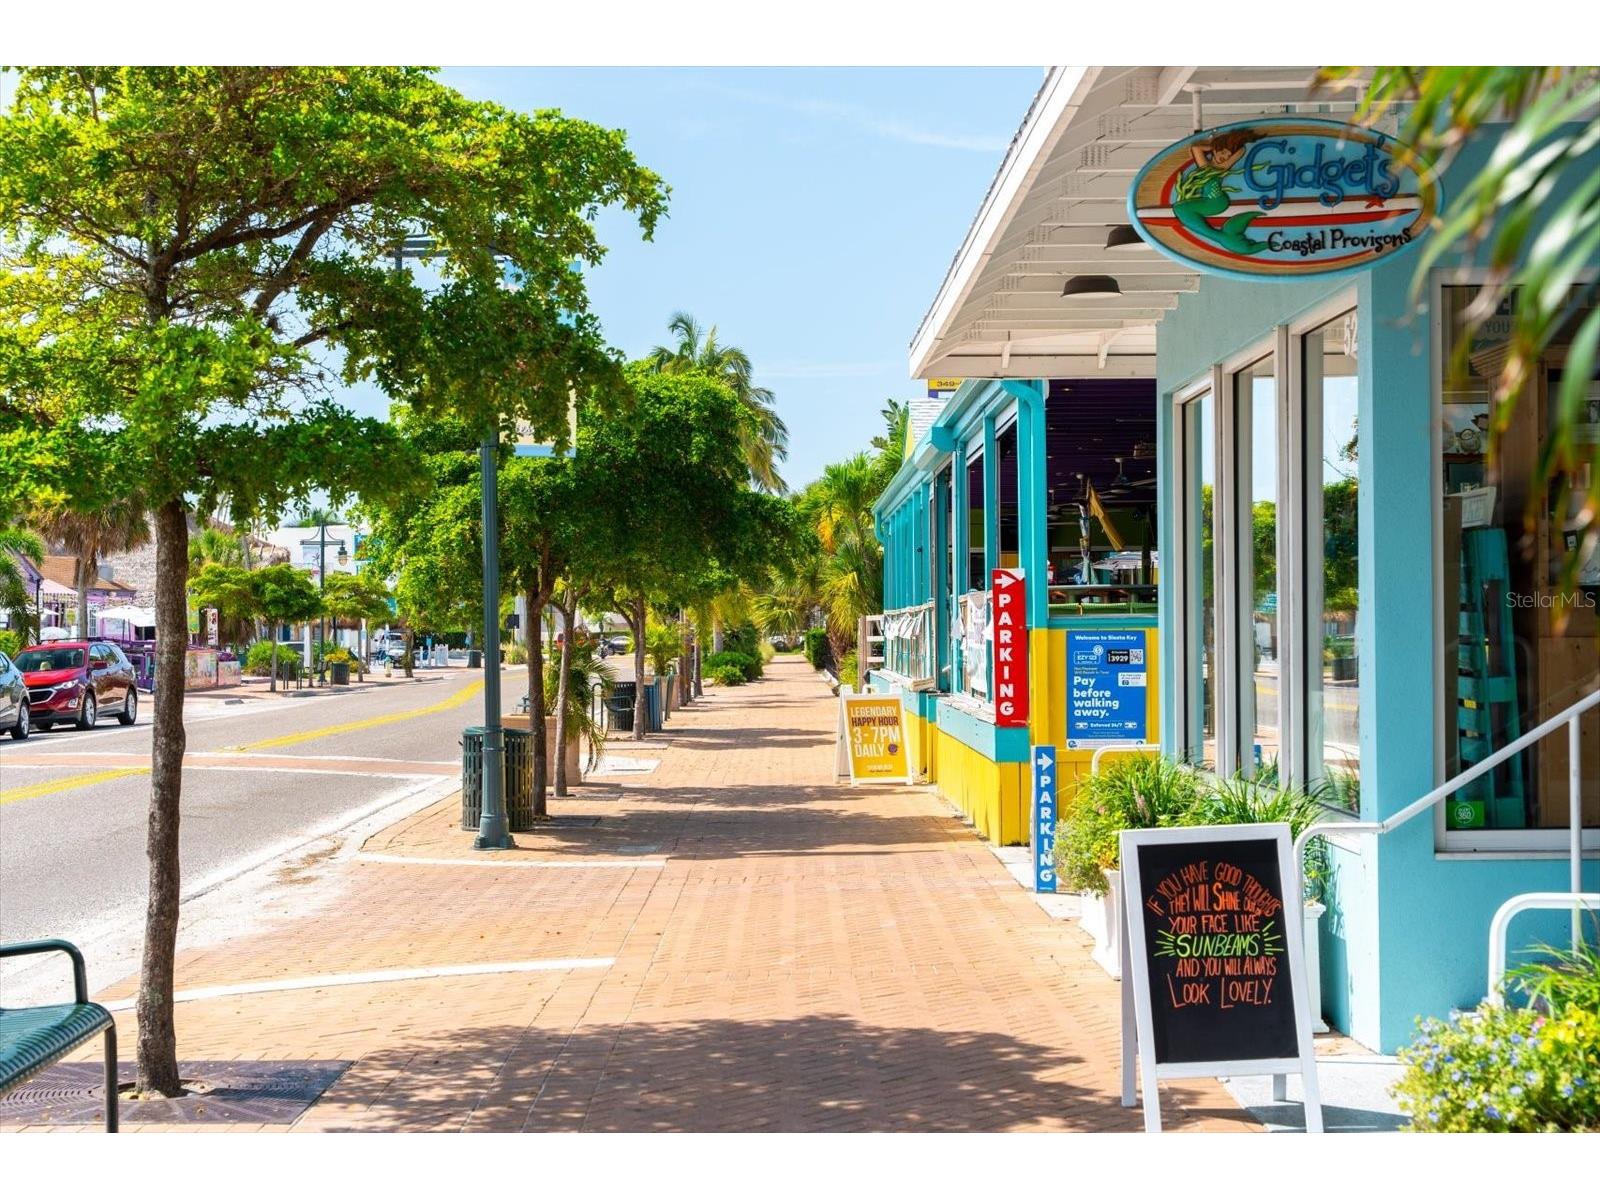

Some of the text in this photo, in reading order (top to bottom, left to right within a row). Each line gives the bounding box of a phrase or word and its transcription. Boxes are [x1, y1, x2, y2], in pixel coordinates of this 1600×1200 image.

[1243, 135, 1400, 211] Gidget's
[1267, 226, 1412, 257] Coastal Provisons
[1126, 634, 1137, 642] Key
[998, 593, 1014, 716] PARKING
[1073, 675, 1096, 688] Pay
[1073, 688, 1111, 698] before
[1073, 698, 1119, 709] walking
[850, 705, 897, 718] LEGENDARY
[851, 716, 899, 727] HAPPY HOUR
[1073, 709, 1110, 719] away.
[854, 743, 885, 758] DAILY
[1040, 775, 1053, 882] PARKING
[1145, 895, 1165, 917] IF
[1156, 873, 1182, 900] YOU
[1180, 860, 1209, 886] HAVE
[1214, 862, 1243, 886] GOOD
[1169, 887, 1191, 915] THEY
[1192, 884, 1210, 912] WILL
[1212, 882, 1240, 912] SHINE
[1168, 914, 1260, 934] YOUR FACE LIKE
[1176, 933, 1260, 957] SUNBEAMS
[1176, 956, 1277, 978] AND YOU WILL ALWAYS
[1167, 973, 1273, 1009] LOOK LOVELY.
